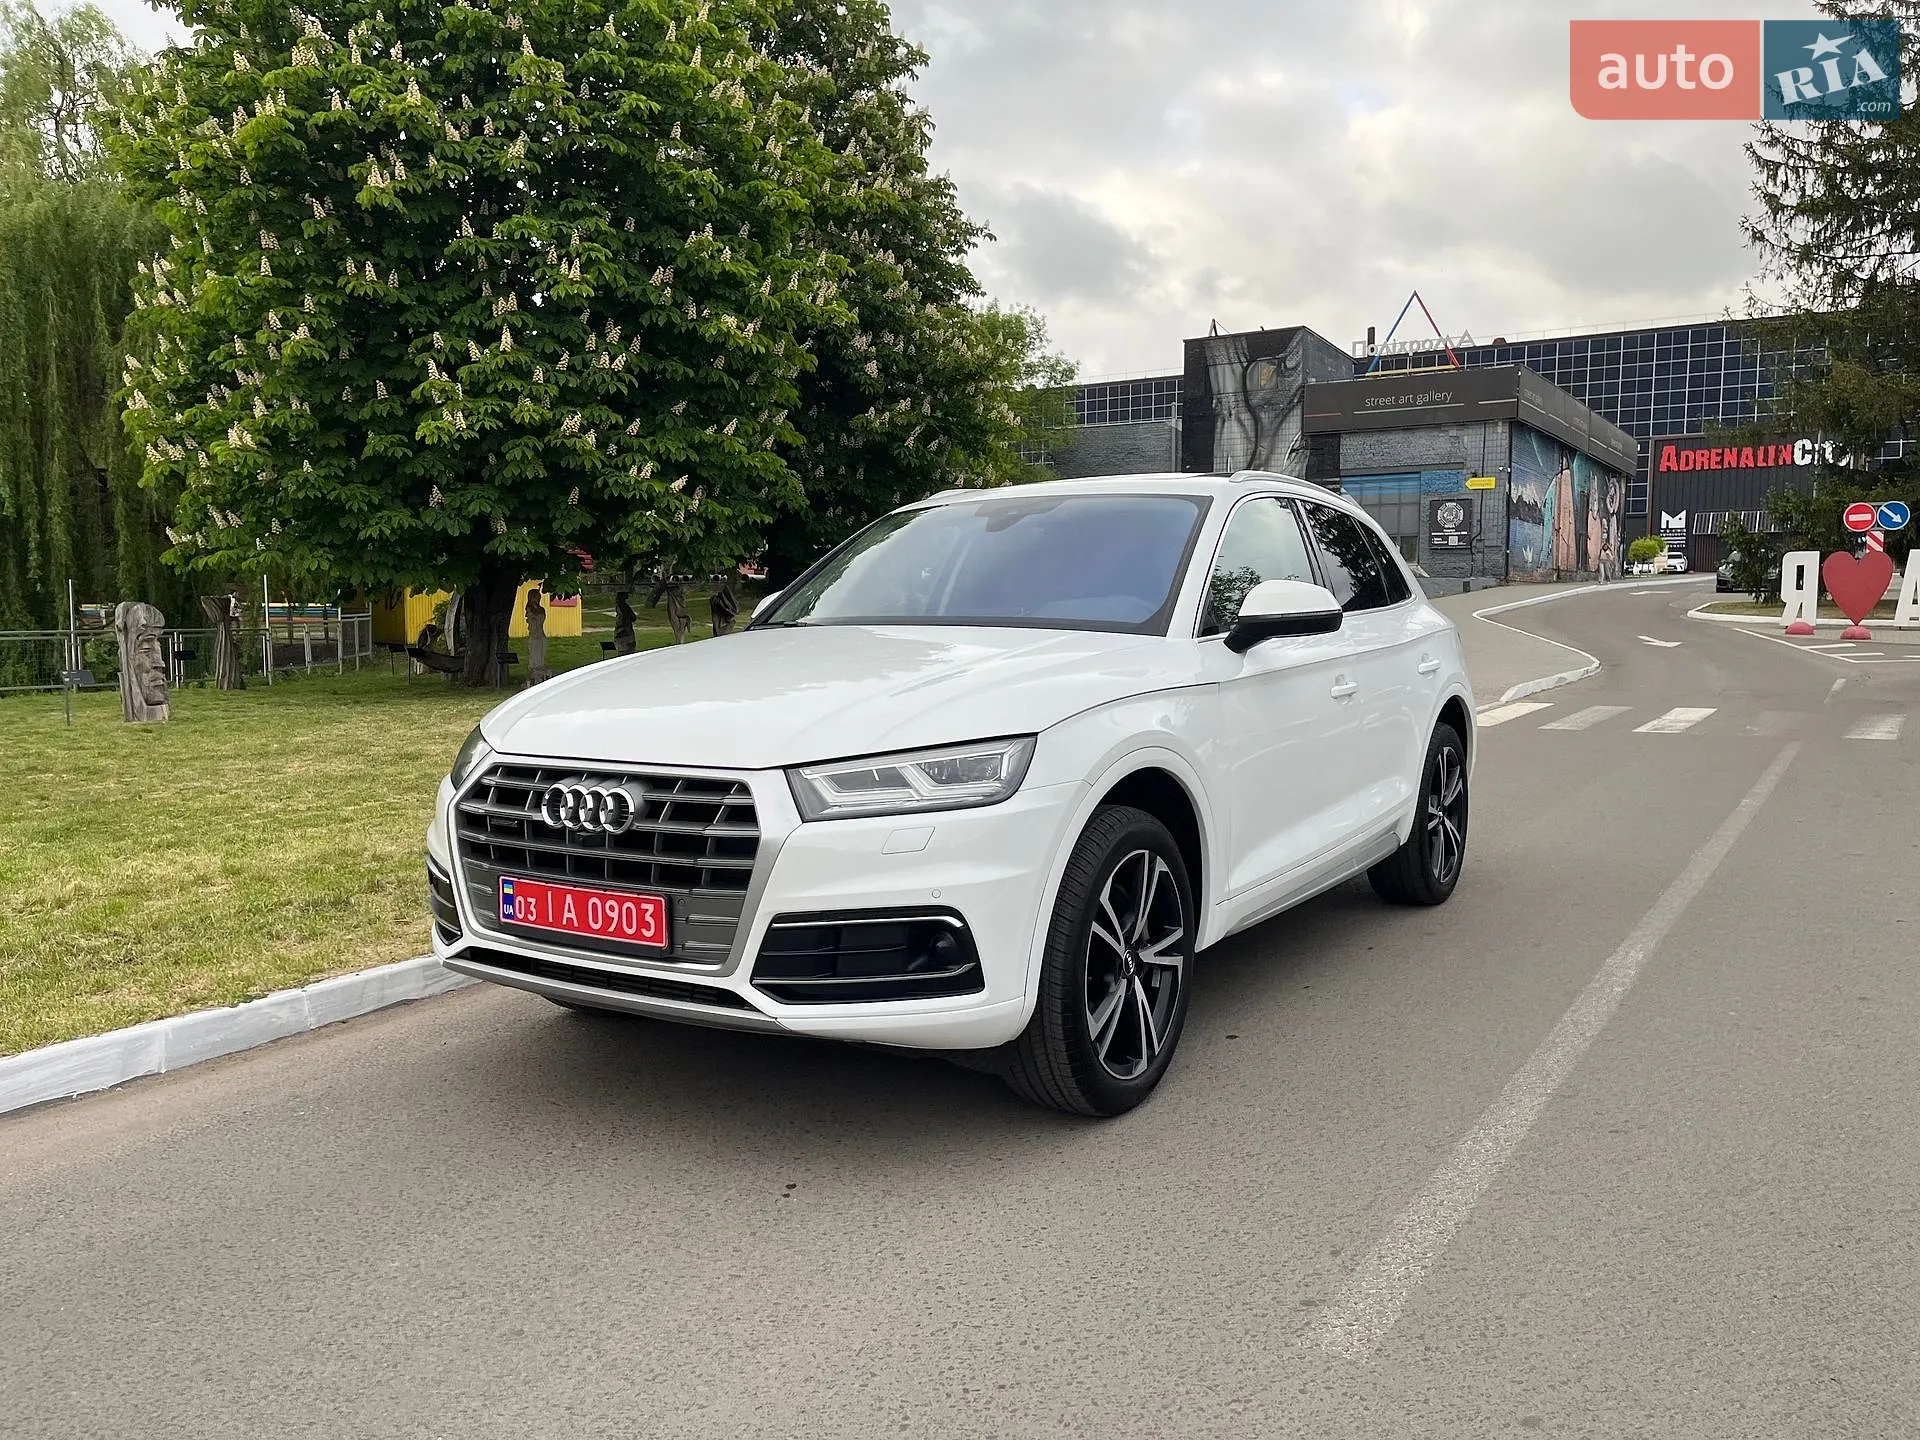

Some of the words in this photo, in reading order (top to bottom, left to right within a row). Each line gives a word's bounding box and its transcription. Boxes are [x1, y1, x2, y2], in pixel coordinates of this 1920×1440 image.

[1365, 395, 1396, 407] street
[1398, 394, 1414, 405] art
[1416, 390, 1453, 405] gallery
[503, 904, 514, 915] UA
[515, 895, 537, 922] 03
[588, 896, 656, 938] 0903
